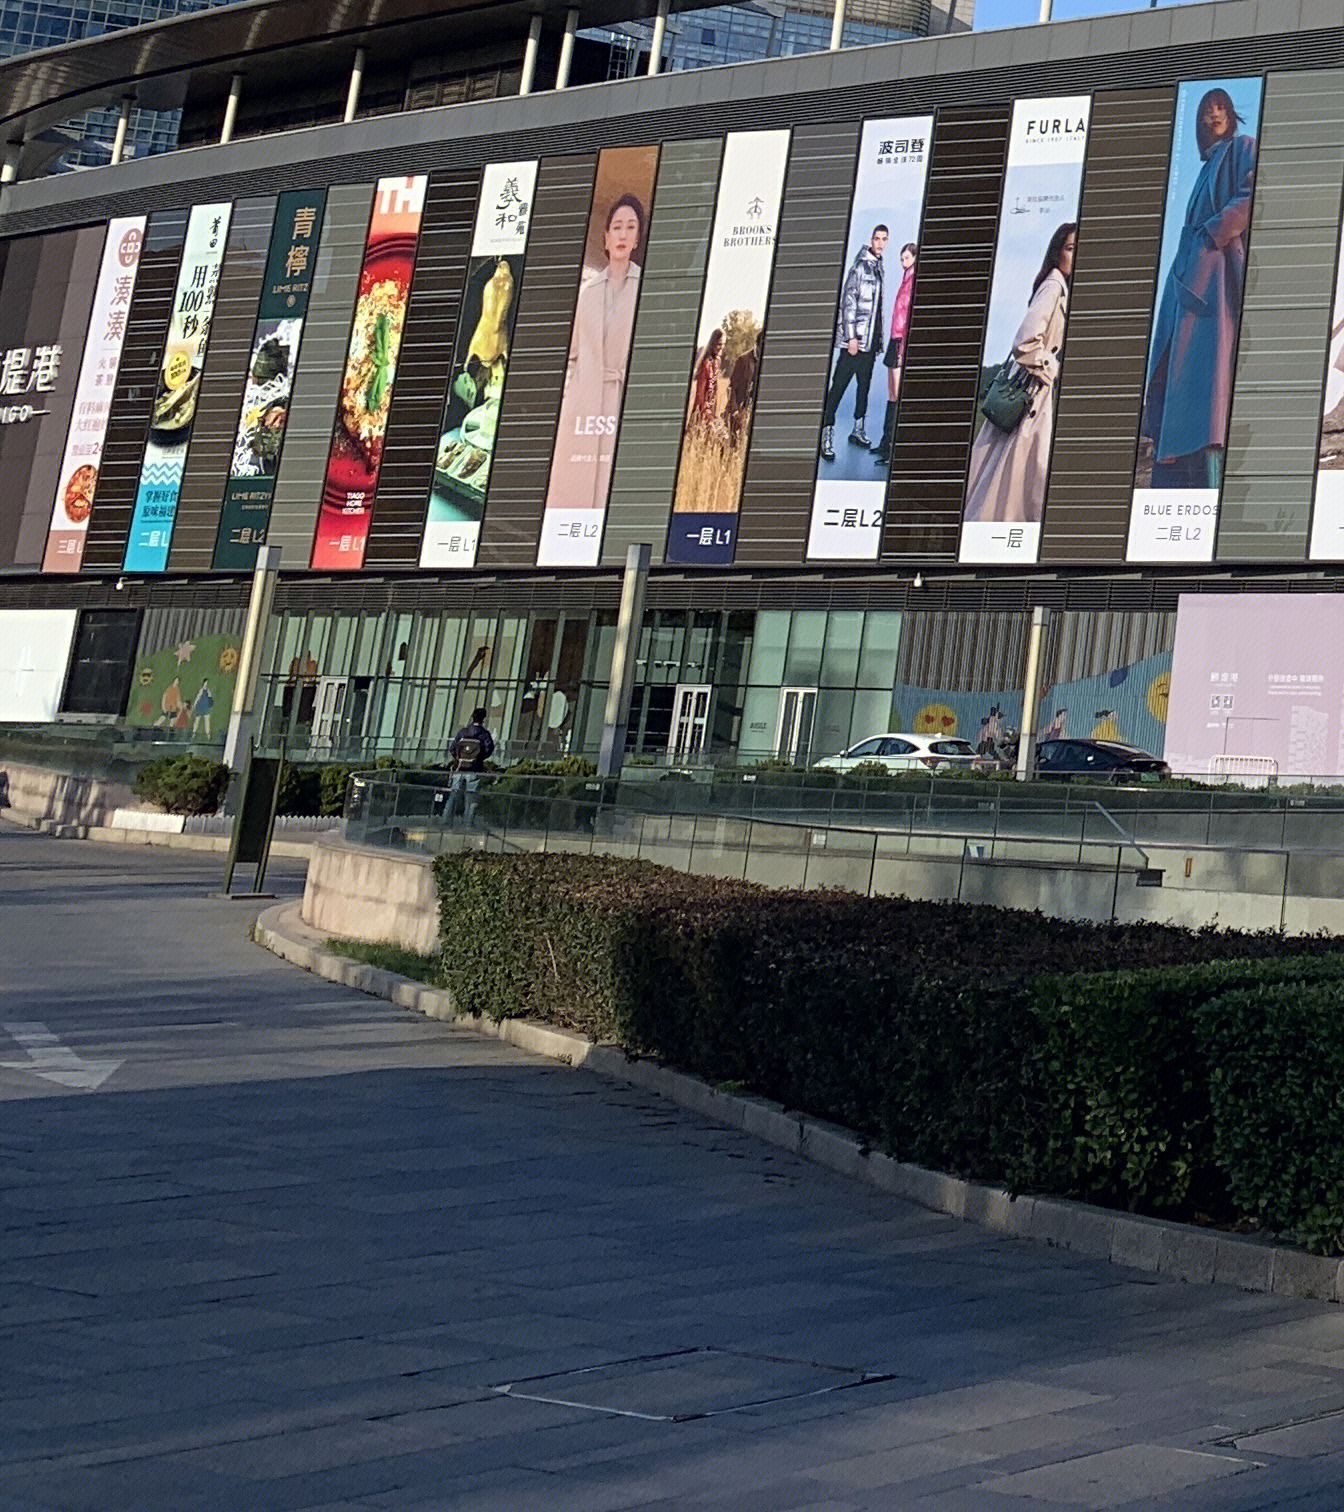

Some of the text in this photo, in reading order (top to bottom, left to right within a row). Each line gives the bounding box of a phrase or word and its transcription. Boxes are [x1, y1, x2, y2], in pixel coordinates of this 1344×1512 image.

[1026, 118, 1085, 135] FURLA
[878, 138, 925, 155] 波司登
[732, 225, 772, 236] BROOKS
[723, 236, 776, 247] BROTHERS
[0, 344, 63, 394] 堤港
[574, 416, 616, 435] LESS
[824, 509, 882, 528] 二层 L2
[1144, 505, 1219, 515] BLUE ERDOS
[230, 527, 252, 544] 二层
[557, 522, 598, 538] 二层 L2
[686, 527, 731, 545] 一层 L1
[991, 528, 1024, 548] 一层
[1156, 526, 1201, 541] 二层 L2
[438, 536, 476, 552] 一层 L1
